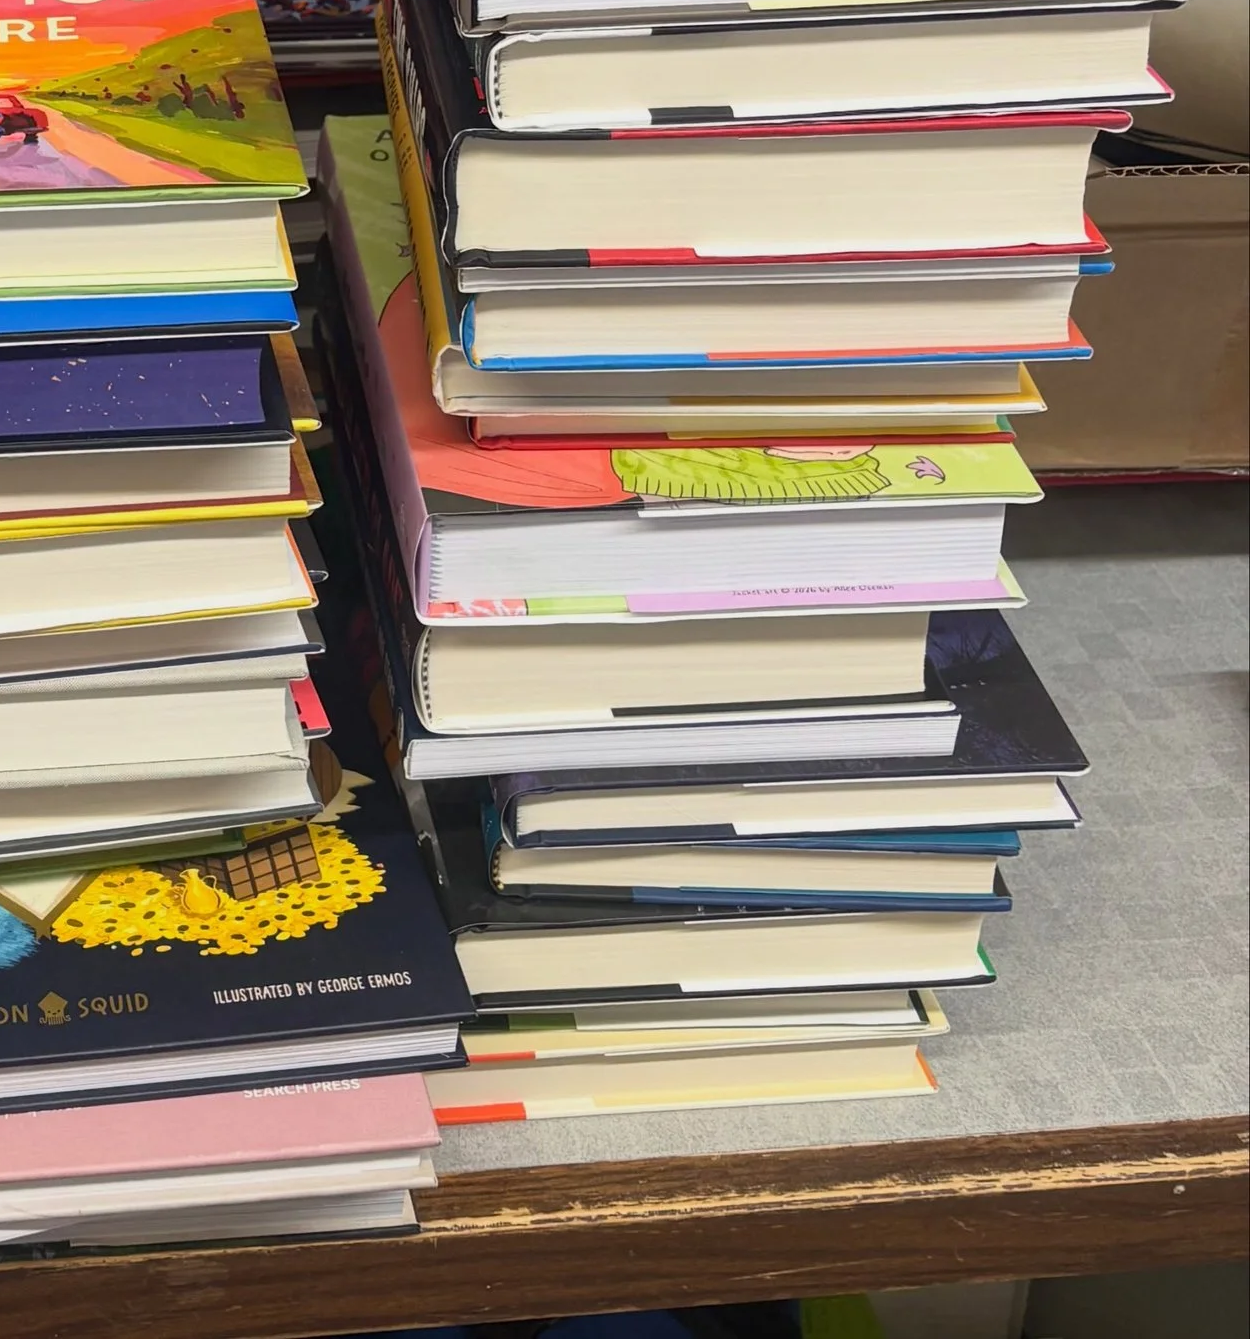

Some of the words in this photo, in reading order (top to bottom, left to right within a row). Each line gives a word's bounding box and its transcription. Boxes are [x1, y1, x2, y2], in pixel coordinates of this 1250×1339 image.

[213, 983, 292, 1005] ILLUSTRATED
[296, 981, 313, 996] BY
[317, 976, 365, 994] GEORGE
[368, 971, 413, 988] ERMOS
[78, 993, 151, 1017] SQUID
[244, 1084, 308, 1099] SEARCH
[313, 1078, 362, 1093] PRESS
